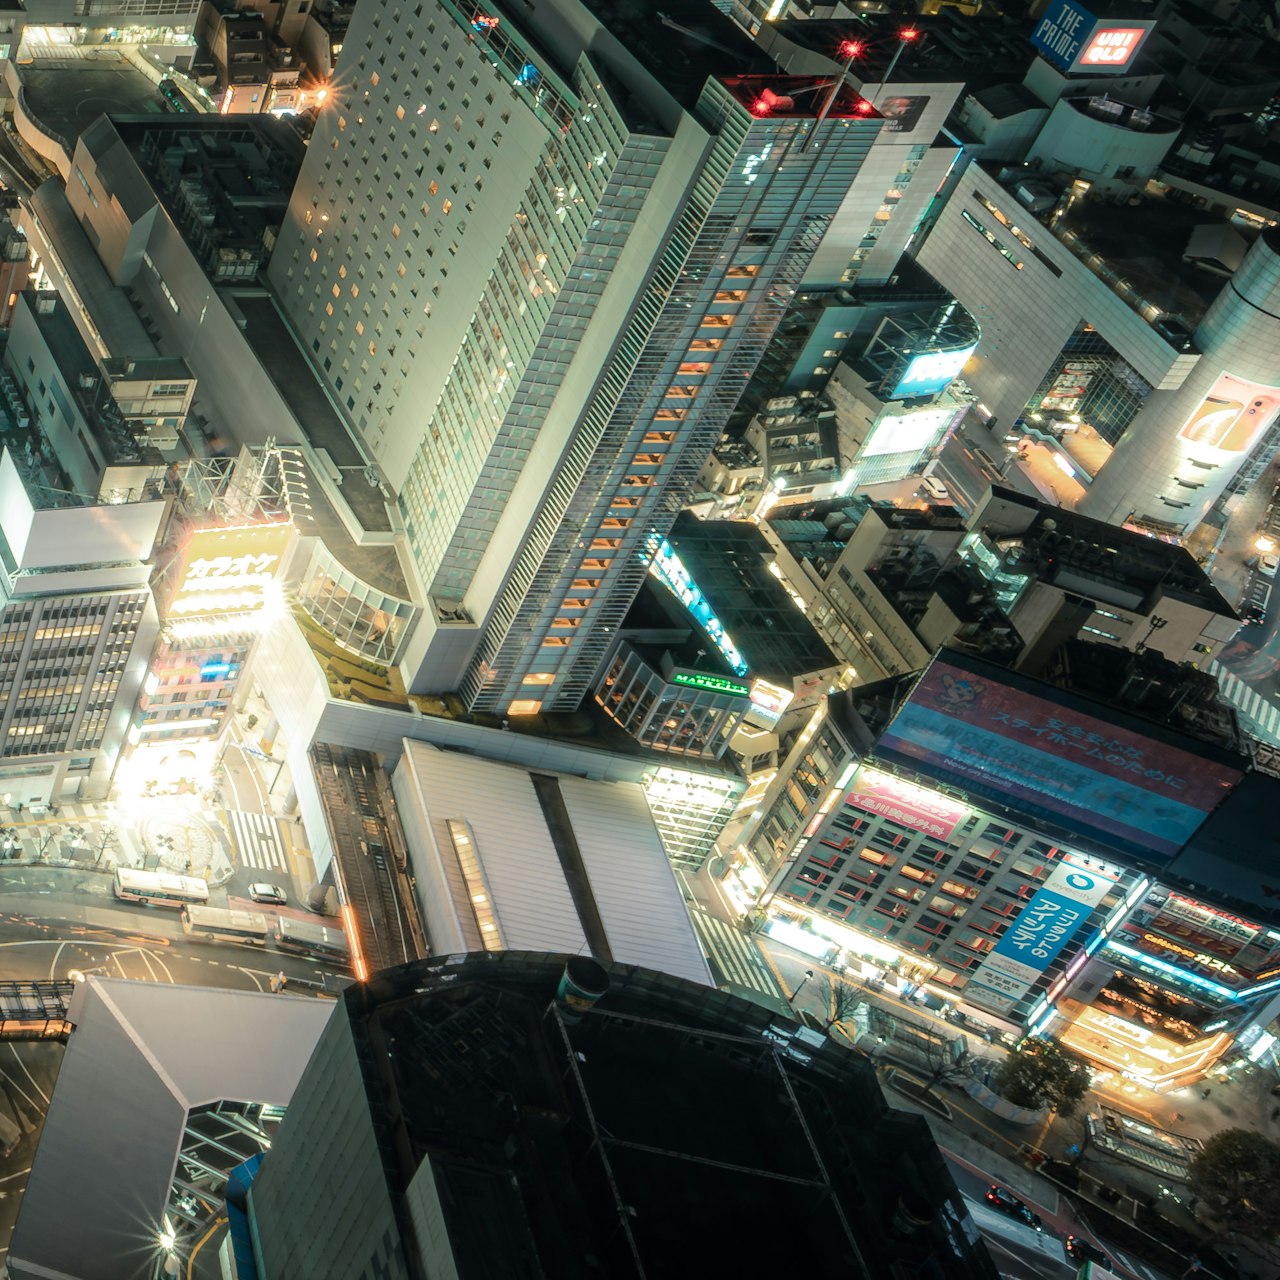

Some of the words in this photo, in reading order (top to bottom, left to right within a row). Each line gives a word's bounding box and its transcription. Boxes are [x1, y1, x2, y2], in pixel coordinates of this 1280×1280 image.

[1060, 3, 1085, 33] THE
[1037, 19, 1079, 62] PRIME
[1096, 31, 1136, 47] UNI
[1088, 45, 1129, 62] QLO
[186, 552, 279, 578] カラオケ
[1050, 881, 1093, 901] eyecity
[1148, 892, 1167, 903] 9F
[1011, 898, 1062, 951] アイシティ
[1031, 908, 1080, 959] コンタクトの
[1115, 931, 1137, 943] 7F
[1194, 953, 1237, 974] ガスト
